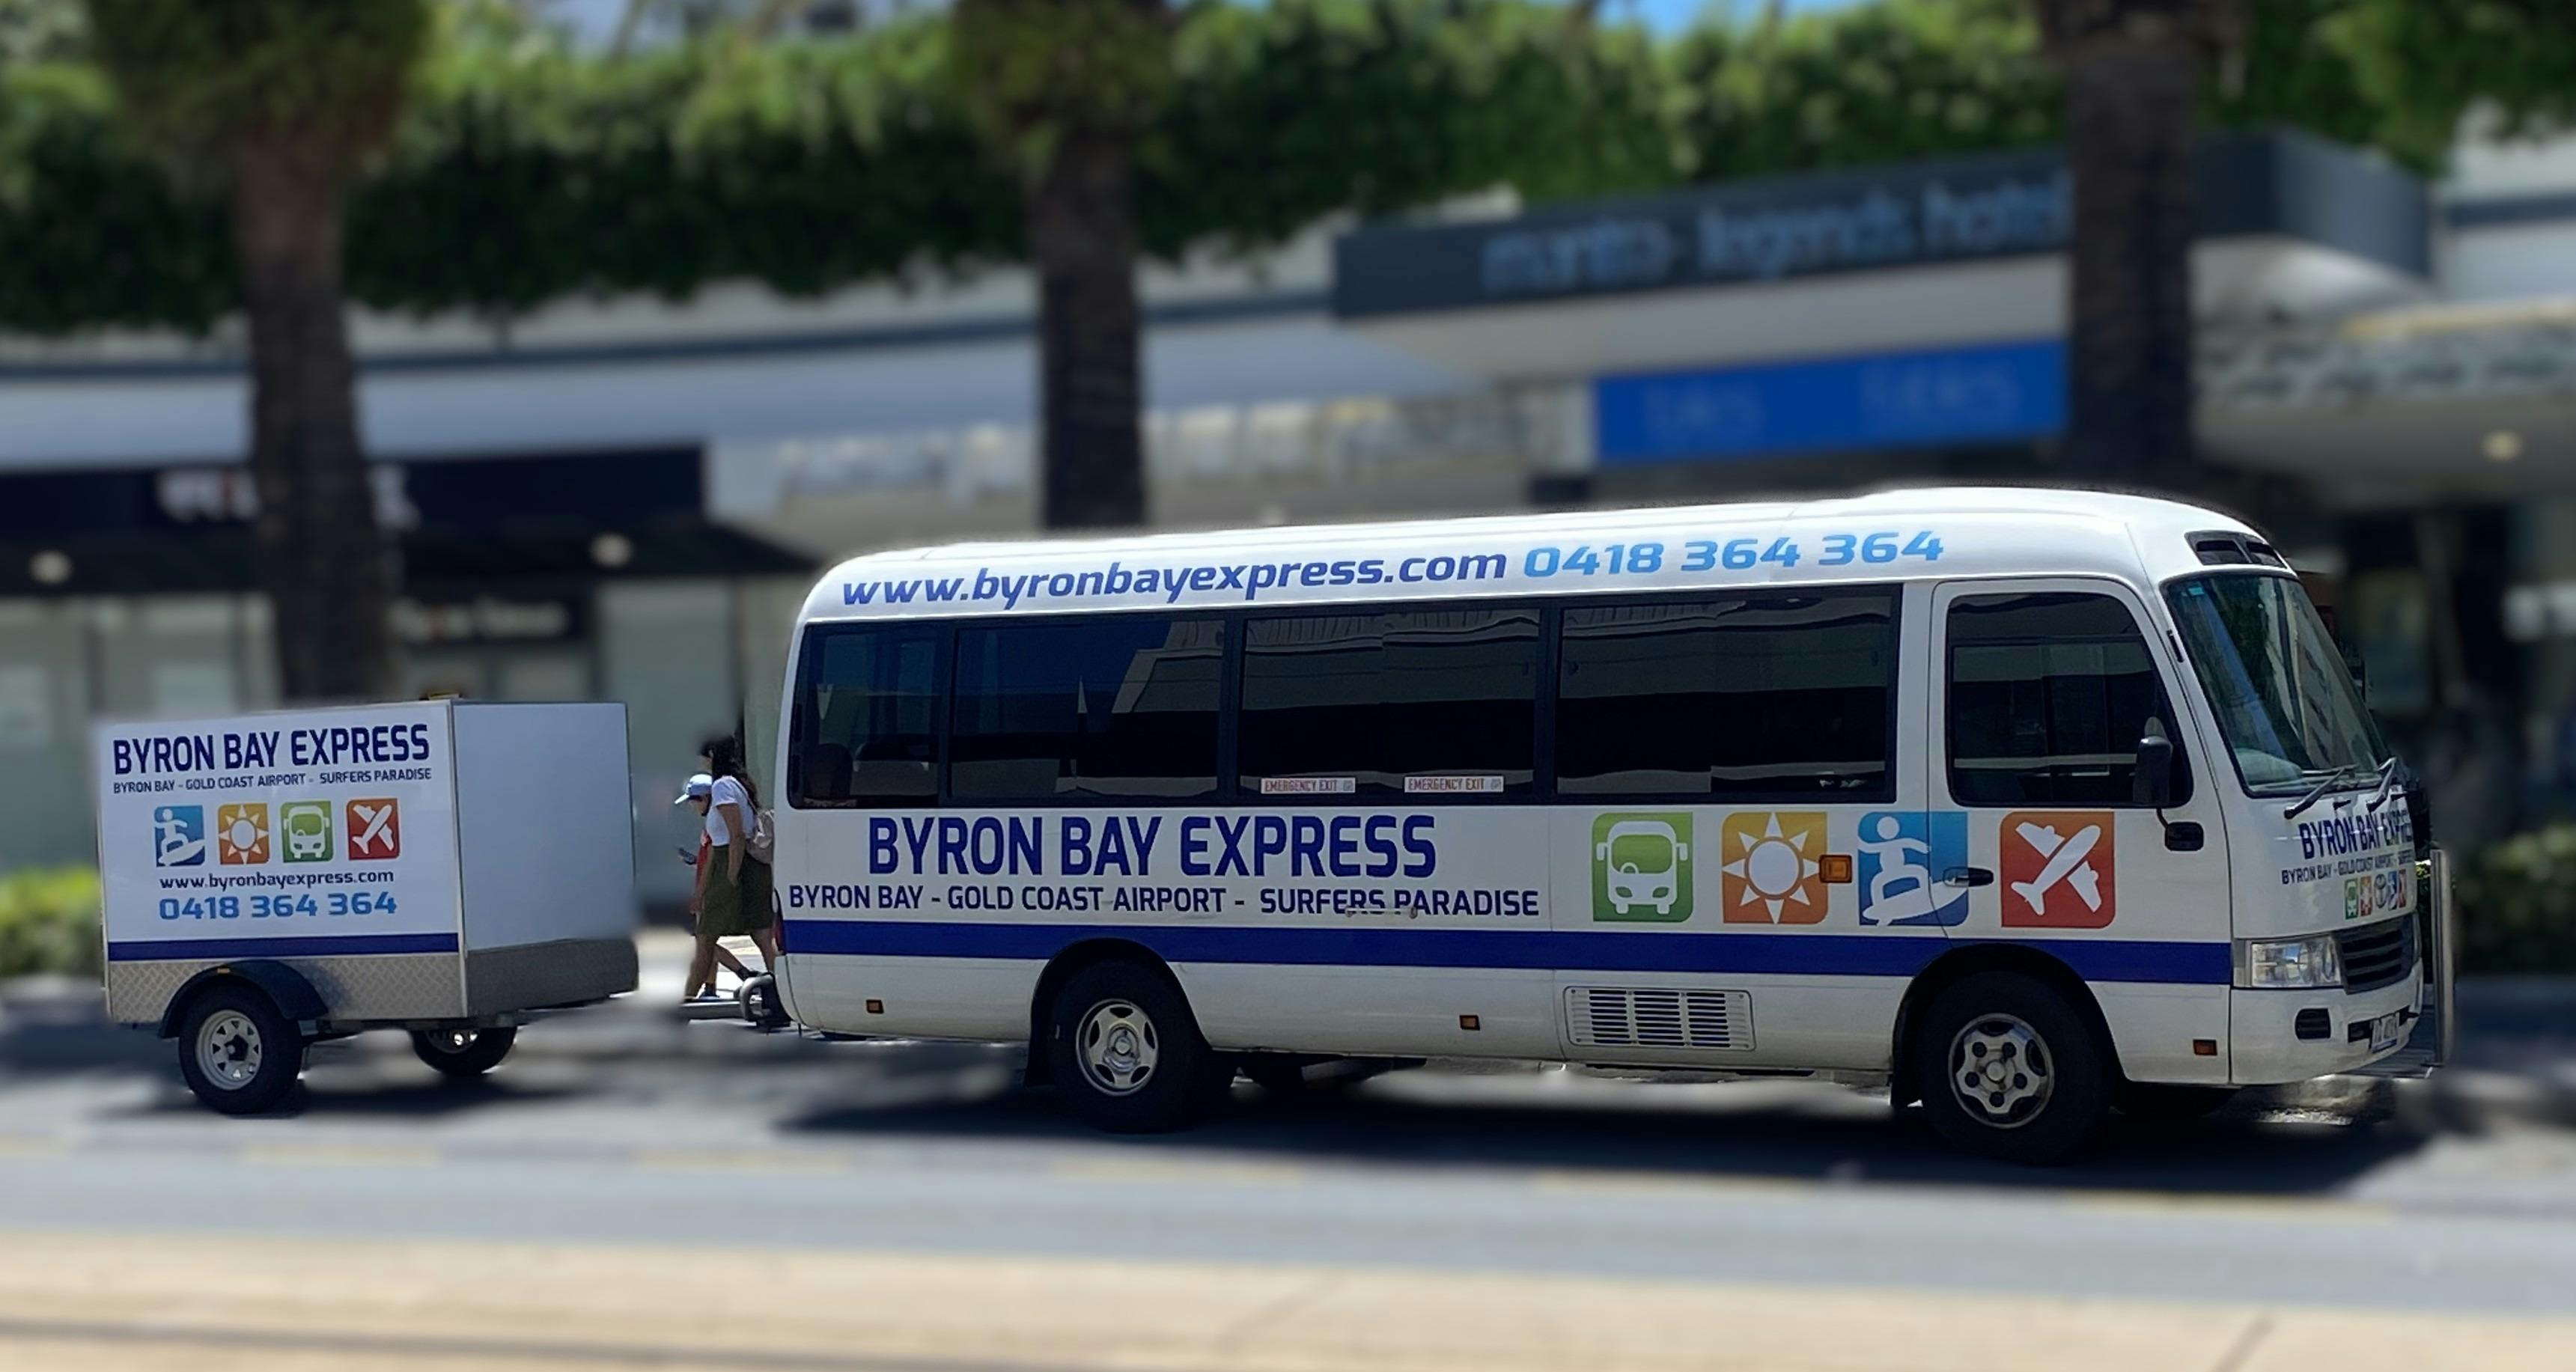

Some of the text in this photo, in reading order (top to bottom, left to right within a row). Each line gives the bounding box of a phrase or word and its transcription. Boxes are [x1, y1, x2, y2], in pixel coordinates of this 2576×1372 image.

[842, 531, 1944, 610] www.byronbayexpress.com 0418 364 364
[113, 724, 430, 775] BYRON BAY EXPRESS
[114, 781, 151, 794] BYRON
[155, 781, 174, 792] BAY
[186, 778, 216, 790] GOLD
[218, 775, 254, 789] COAST
[258, 773, 305, 787] AIRPORT
[319, 770, 371, 784] SURFERS
[374, 768, 432, 782] PARADISE
[1265, 779, 1337, 791] EMERGENCY EXIT
[1408, 778, 1484, 790] EMERGENCY EXIT
[869, 815, 1437, 878] BYRON BAY EXPRESS
[2299, 817, 2357, 859] BYRON
[2357, 814, 2381, 850] BAY
[159, 868, 395, 891] www.byronbayexpress.com
[2282, 865, 2315, 884] BYRON
[159, 891, 397, 920] 0418 364 364
[790, 885, 870, 909] BYRON
[878, 885, 924, 909] BAY
[949, 885, 1014, 910] GOLD
[1022, 886, 1103, 912] COAST
[1113, 888, 1226, 913] AIRPORT
[1261, 888, 1385, 915] SURFERS
[1394, 890, 1539, 916] PARADISE
